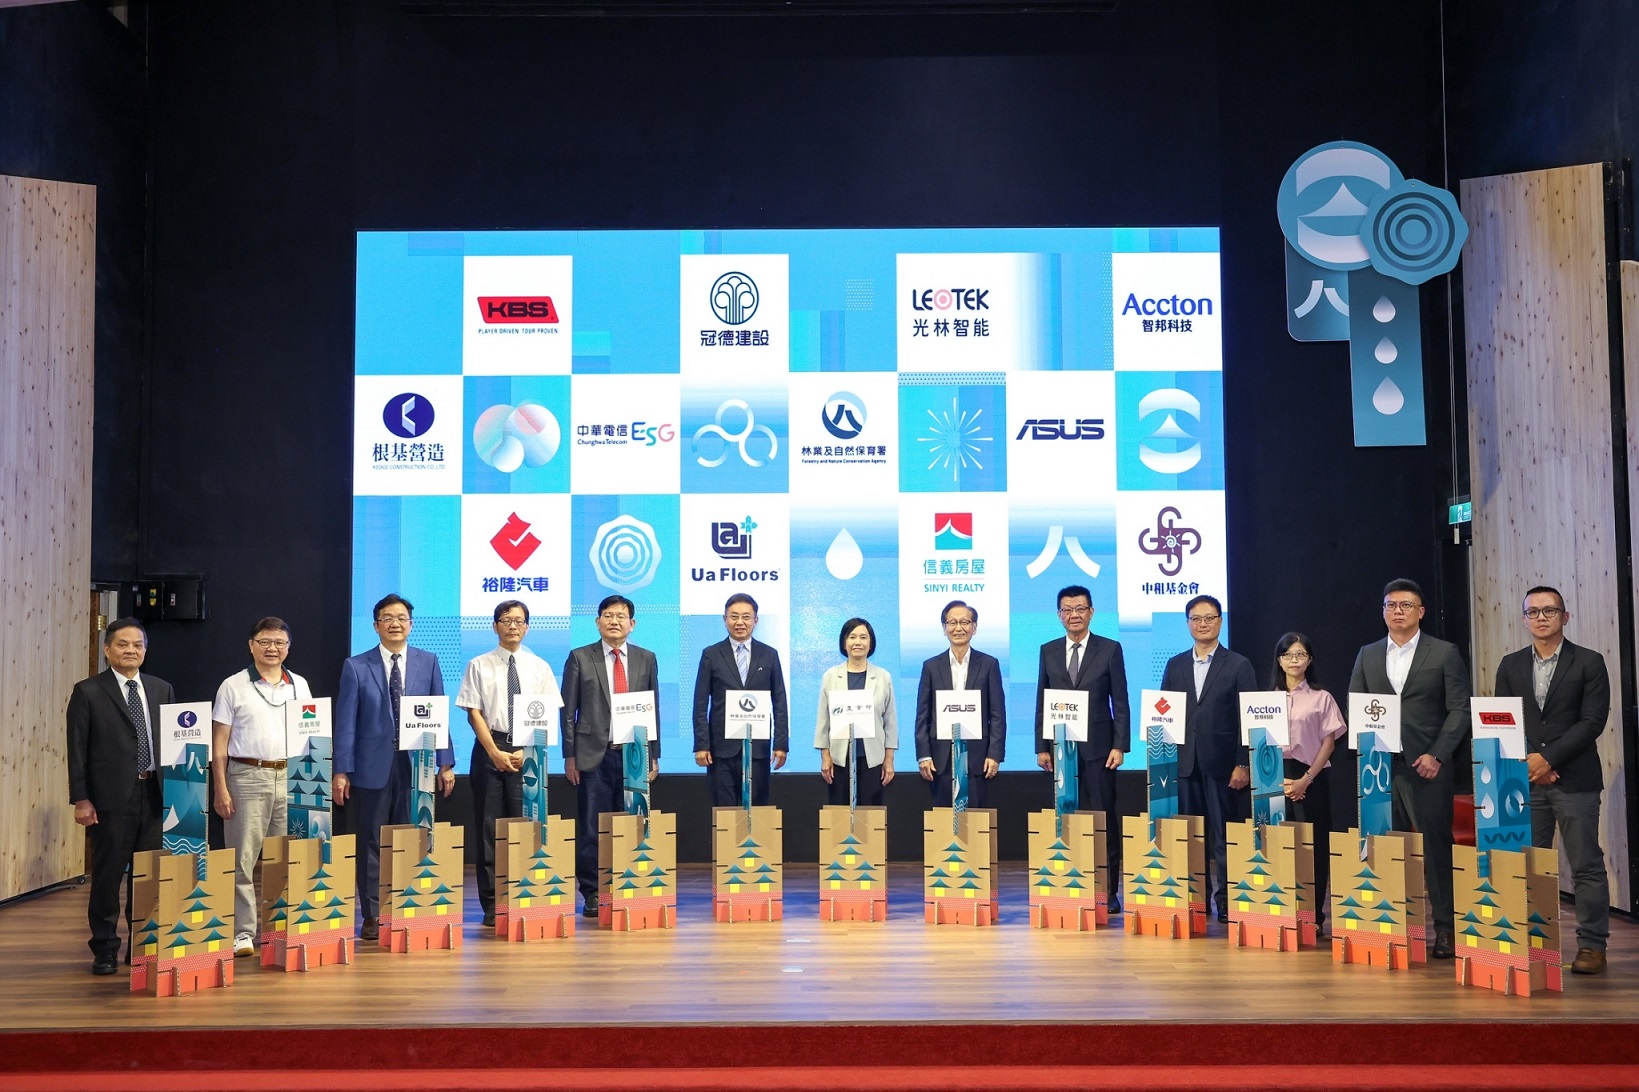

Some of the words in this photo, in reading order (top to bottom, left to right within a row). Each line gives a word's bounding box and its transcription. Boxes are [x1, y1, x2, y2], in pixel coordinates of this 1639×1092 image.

[912, 288, 989, 311] LEOTEK
[1122, 293, 1213, 315] Accton
[488, 301, 549, 318] KBS
[912, 319, 990, 338] 光林智能
[1142, 319, 1193, 333] 智邦科技
[700, 330, 770, 347] 冠德建設
[577, 424, 628, 437] 中華電信
[631, 421, 675, 446] ESG
[1016, 419, 1105, 440] ASUS
[372, 442, 445, 462] 根基營造
[801, 445, 887, 457] 林業及自然保育署
[691, 567, 717, 582] Ua
[720, 567, 779, 582] Floors
[923, 558, 986, 575] 信義房屋
[482, 576, 549, 592] 裕隆汽車
[924, 583, 949, 592] SINYI
[952, 583, 985, 592] REALTY
[1141, 581, 1200, 596] 中租基金會
[942, 704, 976, 713] ASUS
[1246, 705, 1282, 714] Accton
